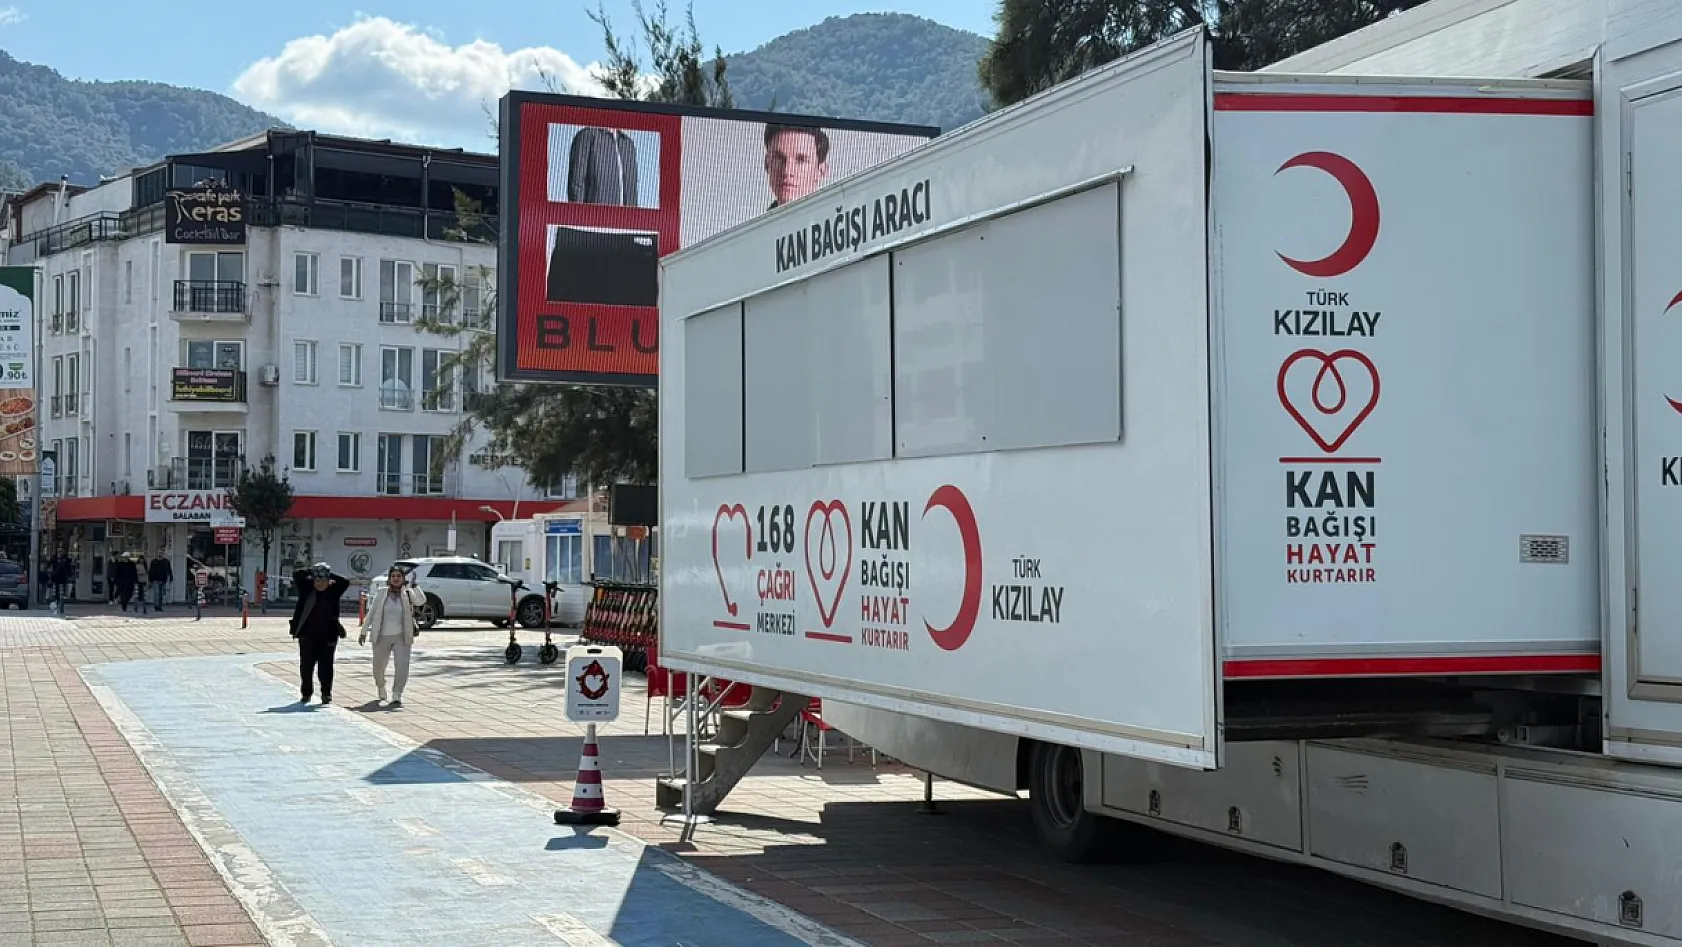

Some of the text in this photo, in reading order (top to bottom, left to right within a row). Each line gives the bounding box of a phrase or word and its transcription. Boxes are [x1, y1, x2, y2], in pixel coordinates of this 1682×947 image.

[218, 189, 241, 205] park
[776, 179, 931, 273] KAN BAĞIŞI ARACI
[1306, 288, 1349, 306] TÜRK
[537, 314, 659, 354] BLU
[1274, 310, 1381, 337] KIZILAY
[150, 493, 234, 509] ECZANE
[1286, 471, 1375, 508] KAN
[757, 504, 795, 553] 168
[861, 501, 910, 550] KAN
[1286, 511, 1376, 541] BAĞIŞI
[1012, 554, 1041, 578] TÜRK
[1286, 543, 1376, 564] HAYAT
[757, 562, 795, 606] ÇAĞRI
[861, 554, 910, 596] BAĞIŞI
[1287, 568, 1376, 583] KURTARIR
[861, 595, 910, 625] HAYAT
[992, 584, 1064, 624] KIZILAY
[757, 610, 795, 636] MERKEZİ
[861, 627, 910, 651] KURTARIR
